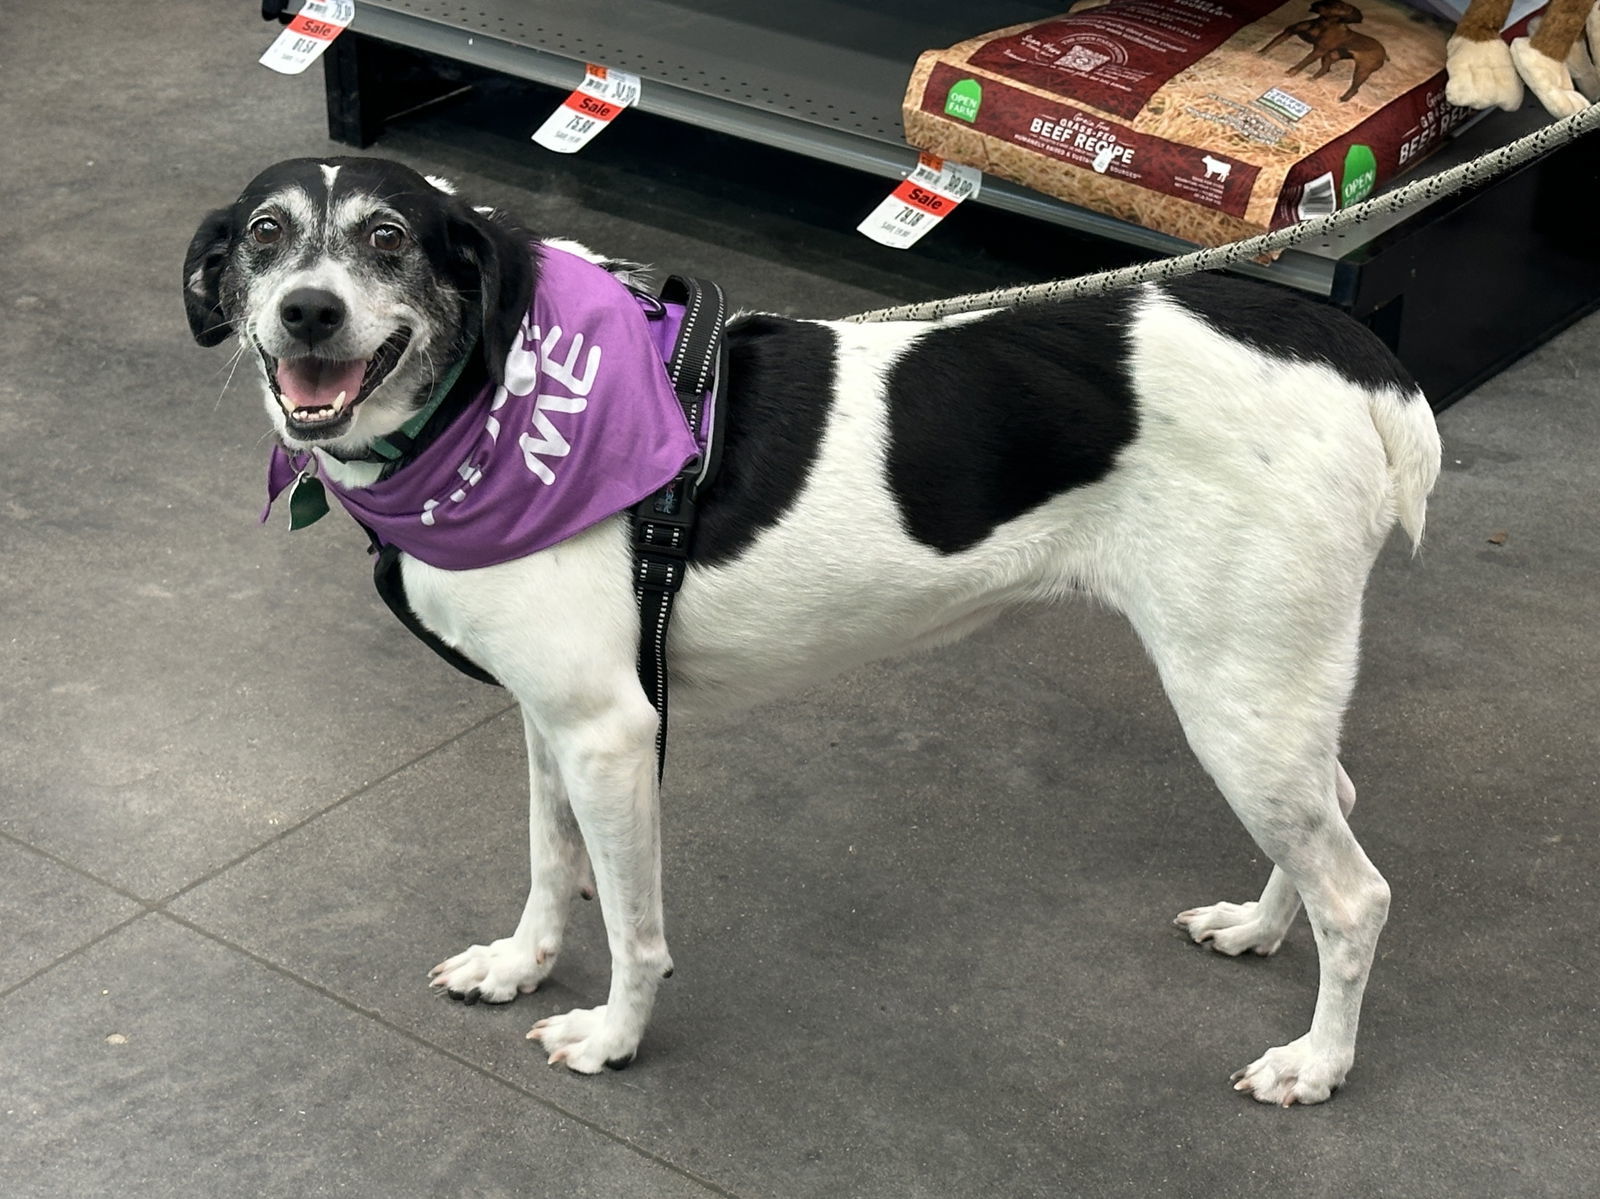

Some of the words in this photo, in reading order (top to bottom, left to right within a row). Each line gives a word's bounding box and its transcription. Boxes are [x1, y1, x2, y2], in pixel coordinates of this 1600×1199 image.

[302, 20, 331, 36] Sale
[579, 97, 611, 117] Sale
[948, 102, 976, 118] FARM
[951, 92, 977, 108] OPEN
[1029, 117, 1074, 143] BEEF
[1073, 112, 1095, 128] Grain
[1399, 123, 1437, 165] BEEF
[1345, 170, 1374, 198] OPEN
[908, 187, 943, 210] Sale
[519, 325, 602, 486] ME
